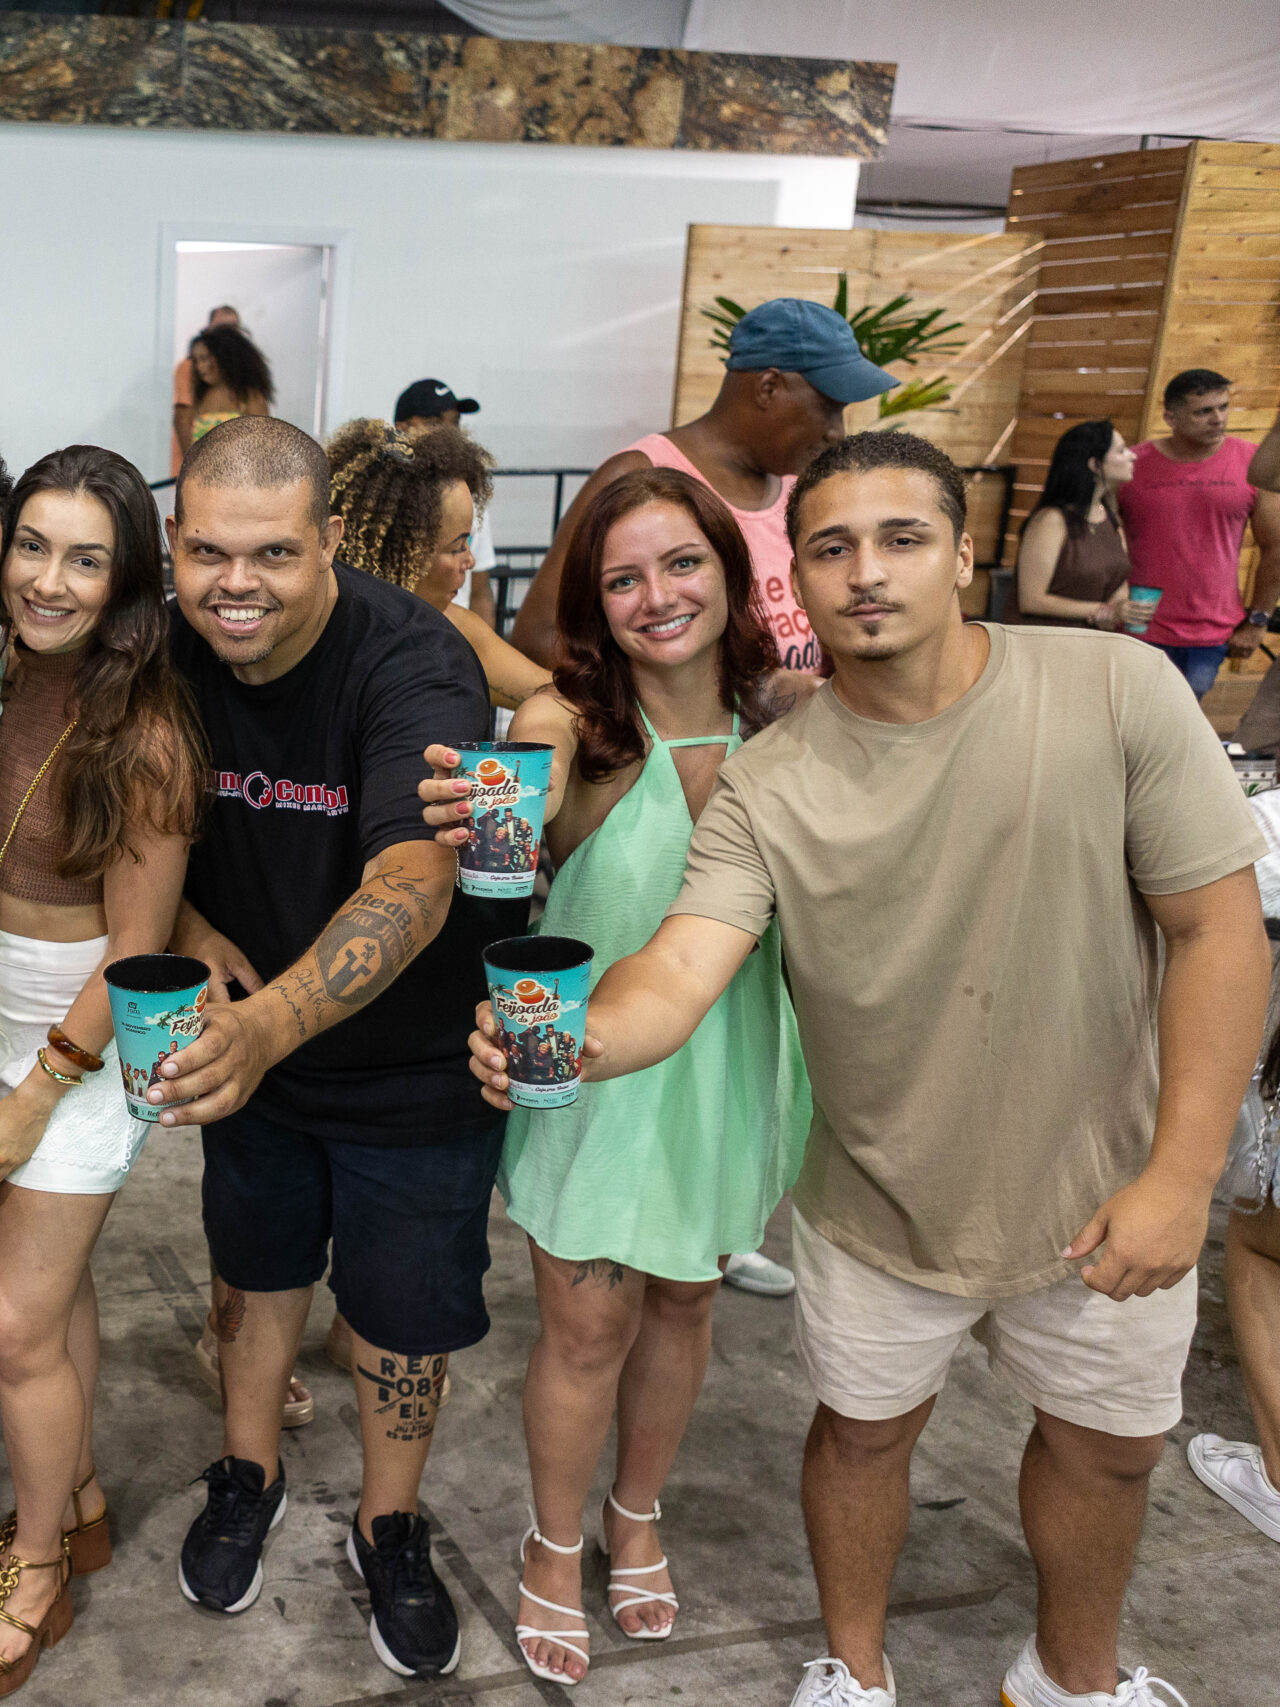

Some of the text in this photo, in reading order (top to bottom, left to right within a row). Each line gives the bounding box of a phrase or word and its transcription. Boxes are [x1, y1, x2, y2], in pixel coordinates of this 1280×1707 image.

[477, 795, 518, 808] do joão
[496, 996, 560, 1018] Feijoada
[517, 1012, 559, 1026] do joão
